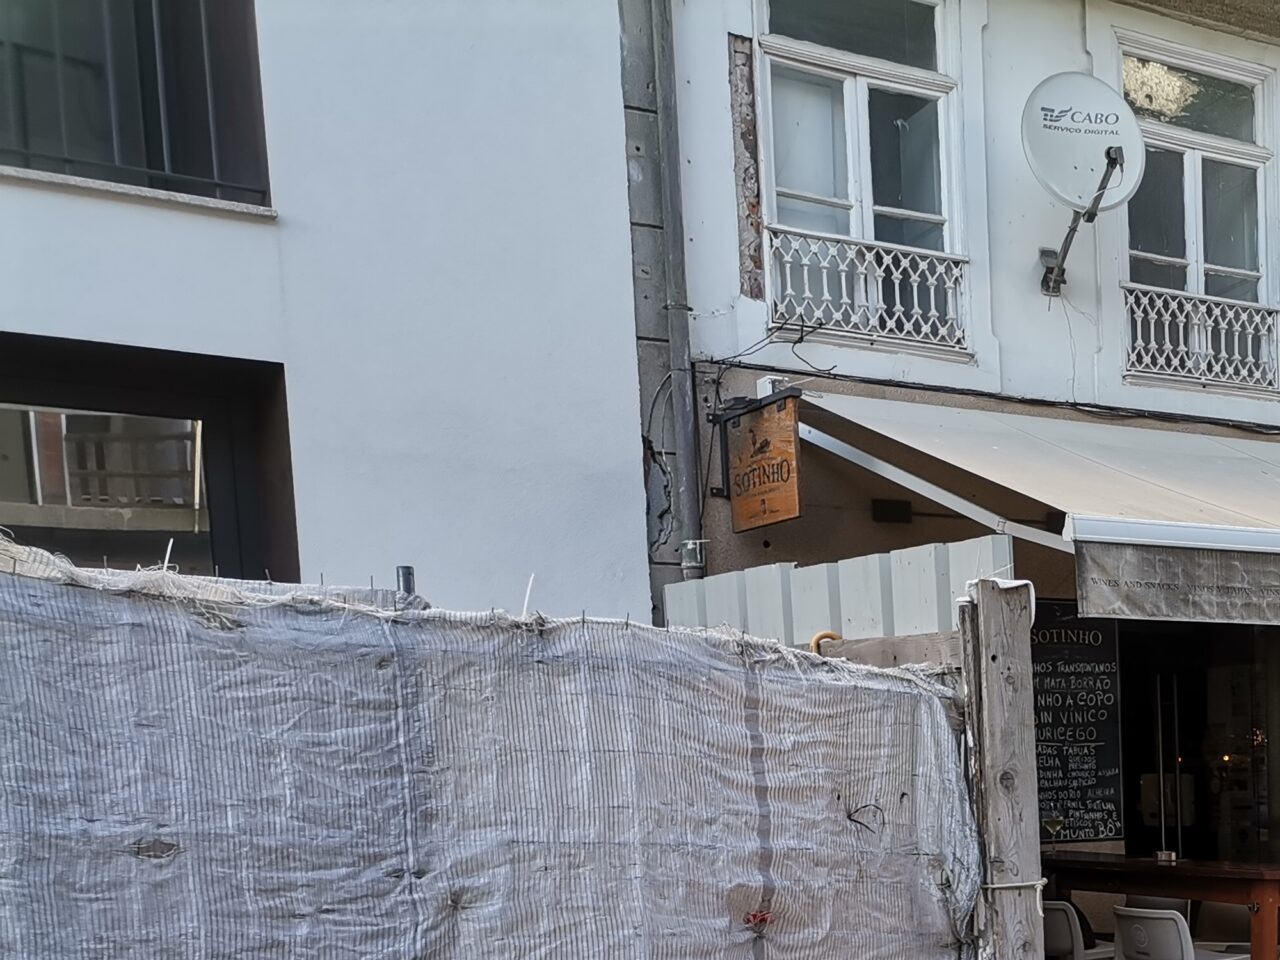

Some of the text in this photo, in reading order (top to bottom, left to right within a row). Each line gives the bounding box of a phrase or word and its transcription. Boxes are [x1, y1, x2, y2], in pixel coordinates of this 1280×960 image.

[1070, 110, 1120, 126] CABO
[1042, 123, 1121, 136] SERVIÇO DIGITAL
[733, 459, 791, 497] SOTINHO
[1090, 577, 1120, 588] WINES
[1123, 579, 1142, 589] AND
[1143, 581, 1180, 592] SNACKS
[1226, 586, 1252, 596] TAPAS
[1031, 629, 1102, 646] SOTINHO
[1033, 661, 1053, 674] HOS
[1037, 691, 1114, 707] NHO A COPO
[1036, 745, 1058, 756] ADAS
[1038, 756, 1061, 768] ELHA
[1039, 769, 1064, 779] DINHA
[1039, 779, 1068, 788] CALHAU
[1039, 790, 1057, 800] NHOS
[1065, 818, 1092, 827] ETISCOS
